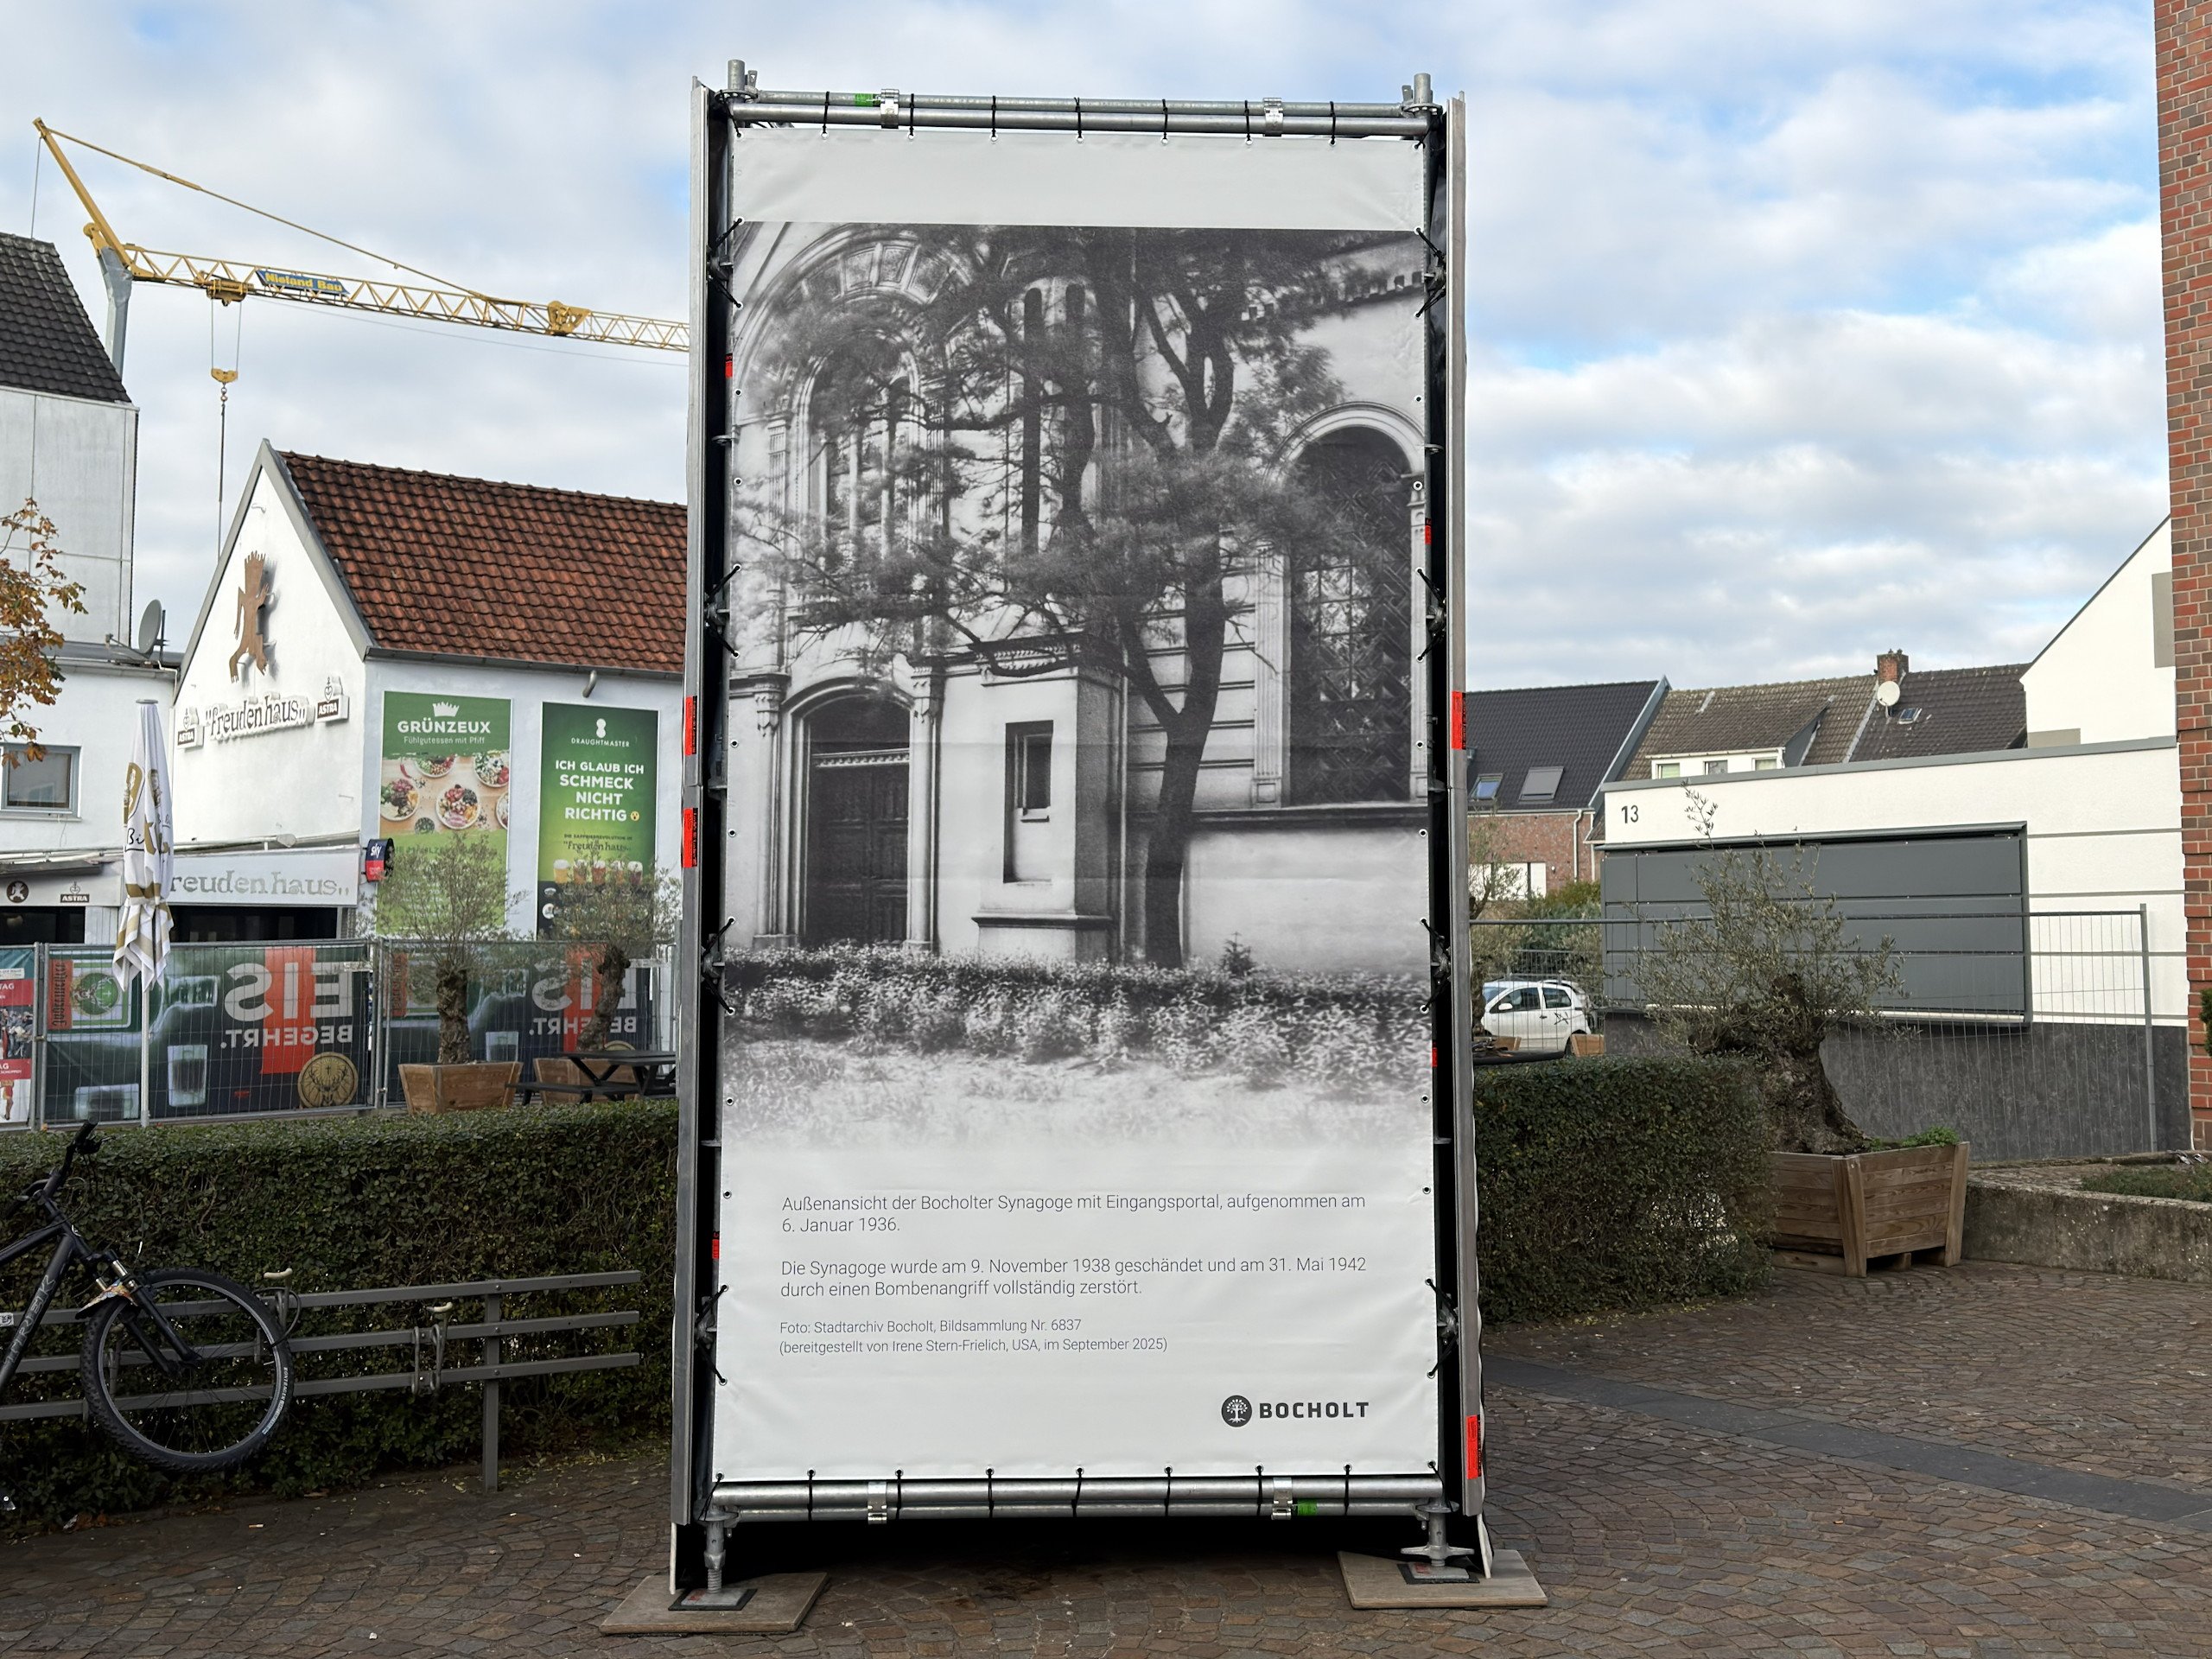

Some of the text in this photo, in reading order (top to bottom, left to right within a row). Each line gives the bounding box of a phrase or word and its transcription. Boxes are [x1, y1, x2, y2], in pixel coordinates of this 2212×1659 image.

[318, 702, 338, 715] ASTRA
[397, 717, 491, 734] GRÜNZEUX
[454, 736, 467, 745] mit
[570, 737, 630, 747] DRAUGHTMASTER
[555, 760, 645, 774] ICH GLAUB ICH
[559, 774, 633, 790] SCHMECK
[575, 791, 623, 805] NICHT
[564, 807, 627, 822] RICHTIG
[1621, 804, 1639, 823] 13
[371, 843, 382, 859] sky
[781, 1192, 1365, 1213] Außenansicht der Bocholter Synagoge mit Eingangsportal, aufgenommen am
[782, 1217, 900, 1233] 6. Januar 1936.
[781, 1256, 1367, 1279] Die Synagoge wurde am 9. November 1938 geschändet und am 31. Mai 1942
[780, 1279, 1142, 1299] durch einen Bombenangriff vollständig zerstört.
[5, 1274, 55, 1365] TREK
[780, 1319, 1082, 1334] Foto: Stadtarchiv Bocholt, Bildsammlung Nr. 6837
[779, 1337, 1167, 1357] (bereitgestellt von Irene Stern-Frielich, USA, im September 2025)
[1259, 1402, 1370, 1419] BOCHOLT
